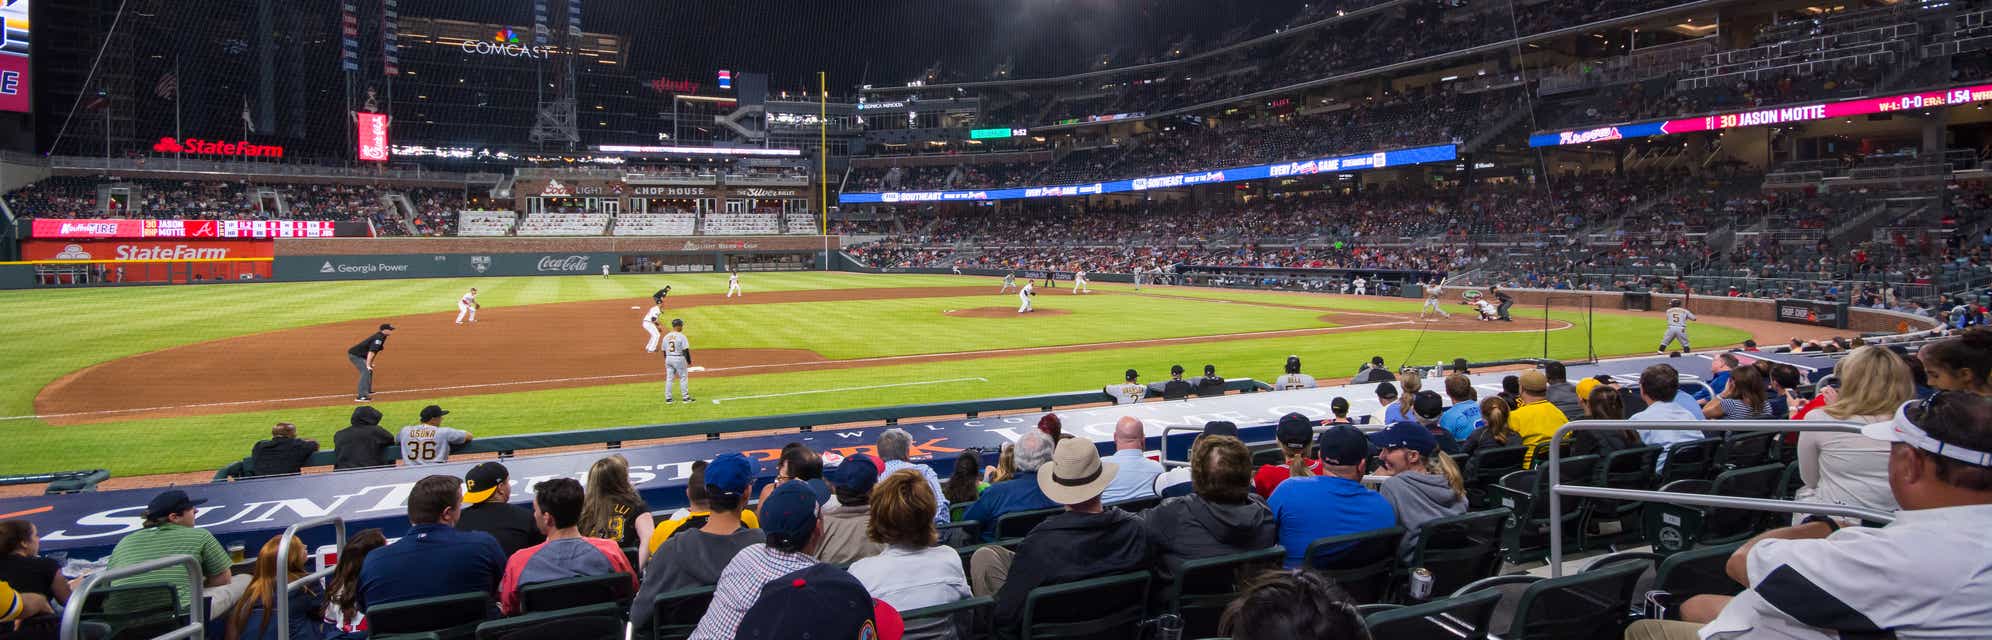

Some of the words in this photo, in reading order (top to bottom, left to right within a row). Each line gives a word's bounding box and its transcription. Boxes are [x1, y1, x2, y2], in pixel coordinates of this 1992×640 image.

[462, 40, 551, 59] COMCAST
[1902, 96, 1923, 109] 0-0
[1923, 97, 1946, 107] ERA:
[1947, 90, 1971, 105] 1.54
[1720, 115, 1736, 128] 30
[1738, 110, 1777, 127] JASON
[1781, 105, 1826, 121] MOTTE
[185, 138, 283, 158] StateFarm
[1270, 164, 1290, 176] EVERY
[1318, 159, 1339, 170] GAME
[1148, 175, 1183, 189] SOUTHEAST
[576, 186, 603, 195] LIGHT
[635, 187, 664, 196] CHOP
[668, 187, 705, 196] HOUSE
[901, 192, 942, 201] SOUTHEAST
[89, 223, 117, 234] TIRE
[159, 220, 184, 228] JASON
[159, 229, 186, 237] MOTTE
[338, 264, 376, 274] Georgia
[378, 263, 408, 272] Power
[1672, 313, 1680, 323] 5
[669, 341, 675, 352] 3
[410, 429, 436, 439] OSUNA
[407, 441, 436, 461] 36
[466, 479, 475, 491] P
